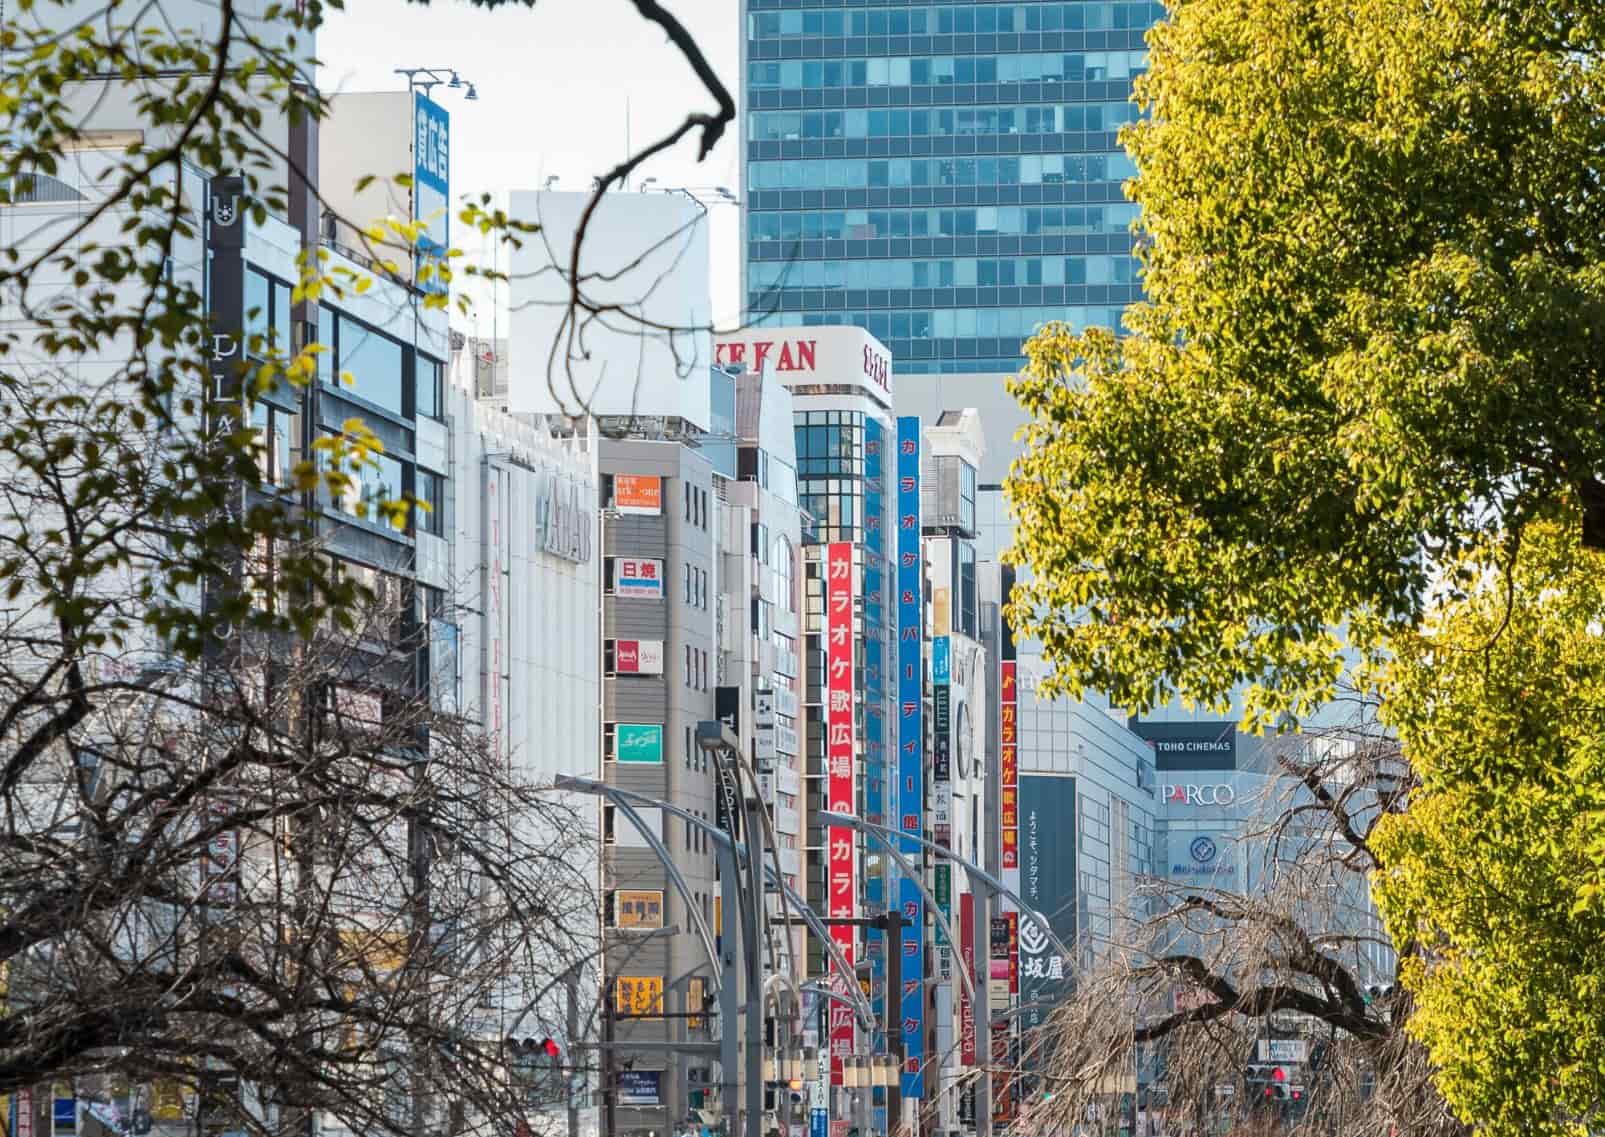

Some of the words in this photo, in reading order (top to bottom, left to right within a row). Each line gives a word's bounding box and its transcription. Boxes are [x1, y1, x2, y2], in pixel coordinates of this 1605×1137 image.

[752, 340, 817, 372] KAN
[1157, 742, 1184, 751] TOHO
[1186, 742, 1231, 751] CINEMAS
[1162, 784, 1234, 806] PARCO
